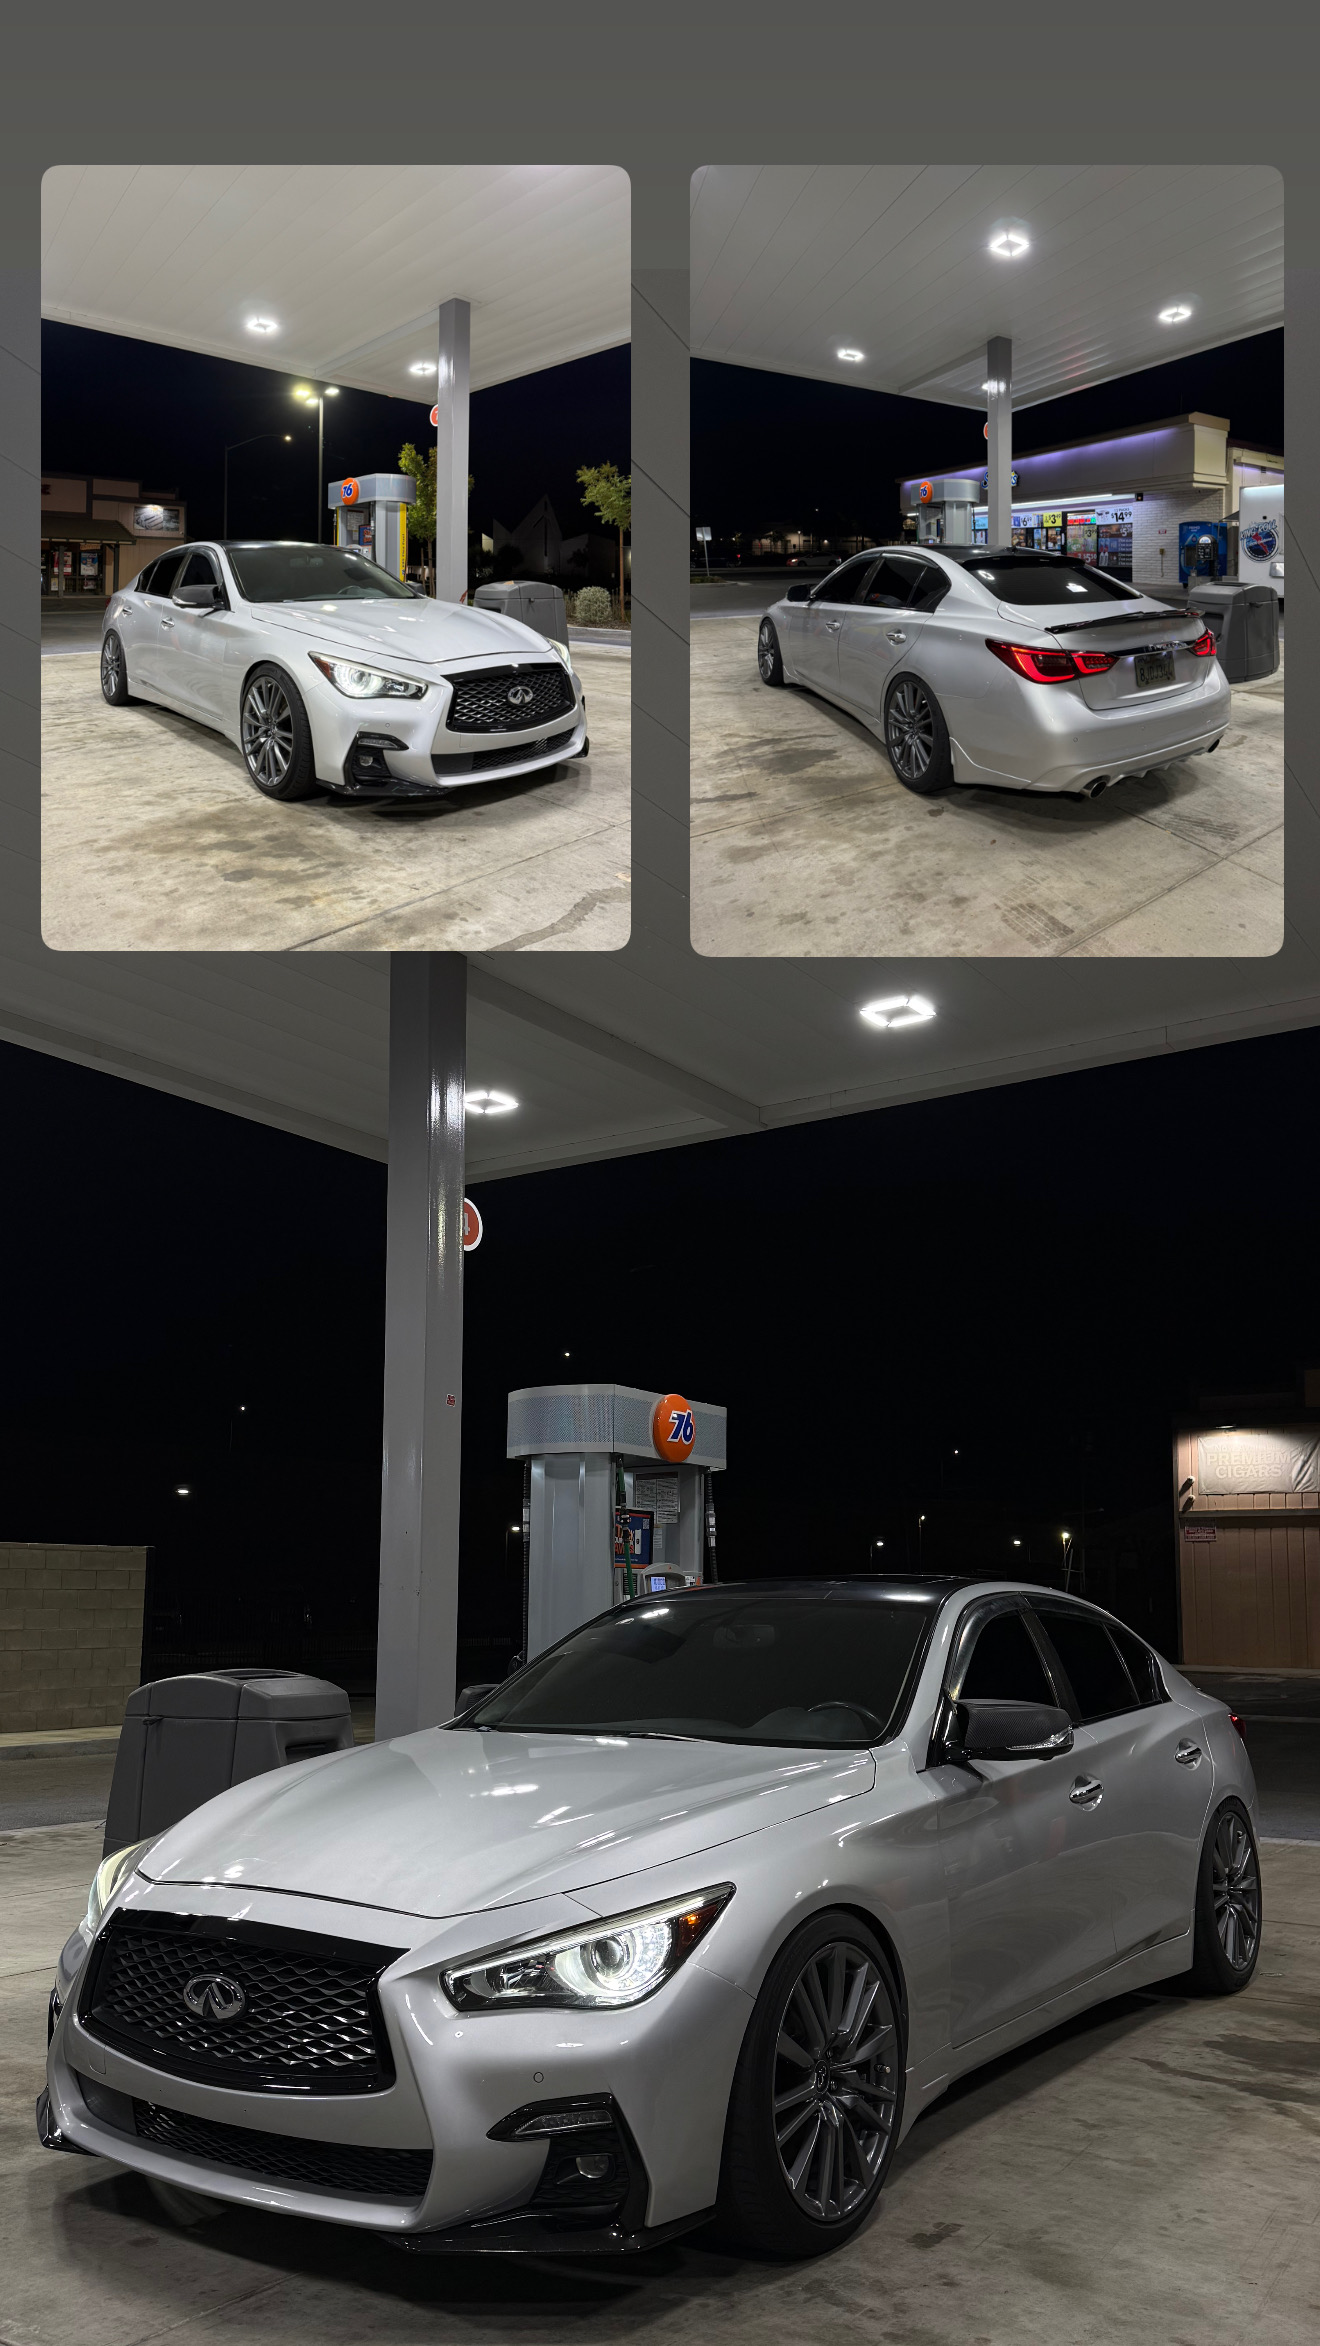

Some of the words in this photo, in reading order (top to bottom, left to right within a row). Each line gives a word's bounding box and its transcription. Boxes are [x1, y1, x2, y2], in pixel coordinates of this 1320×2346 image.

[342, 483, 353, 498] 76
[920, 486, 928, 498] 76
[668, 1409, 695, 1445] 76
[1206, 1452, 1291, 1465] PREMIUM
[1215, 1464, 1282, 1478] CIGARS
